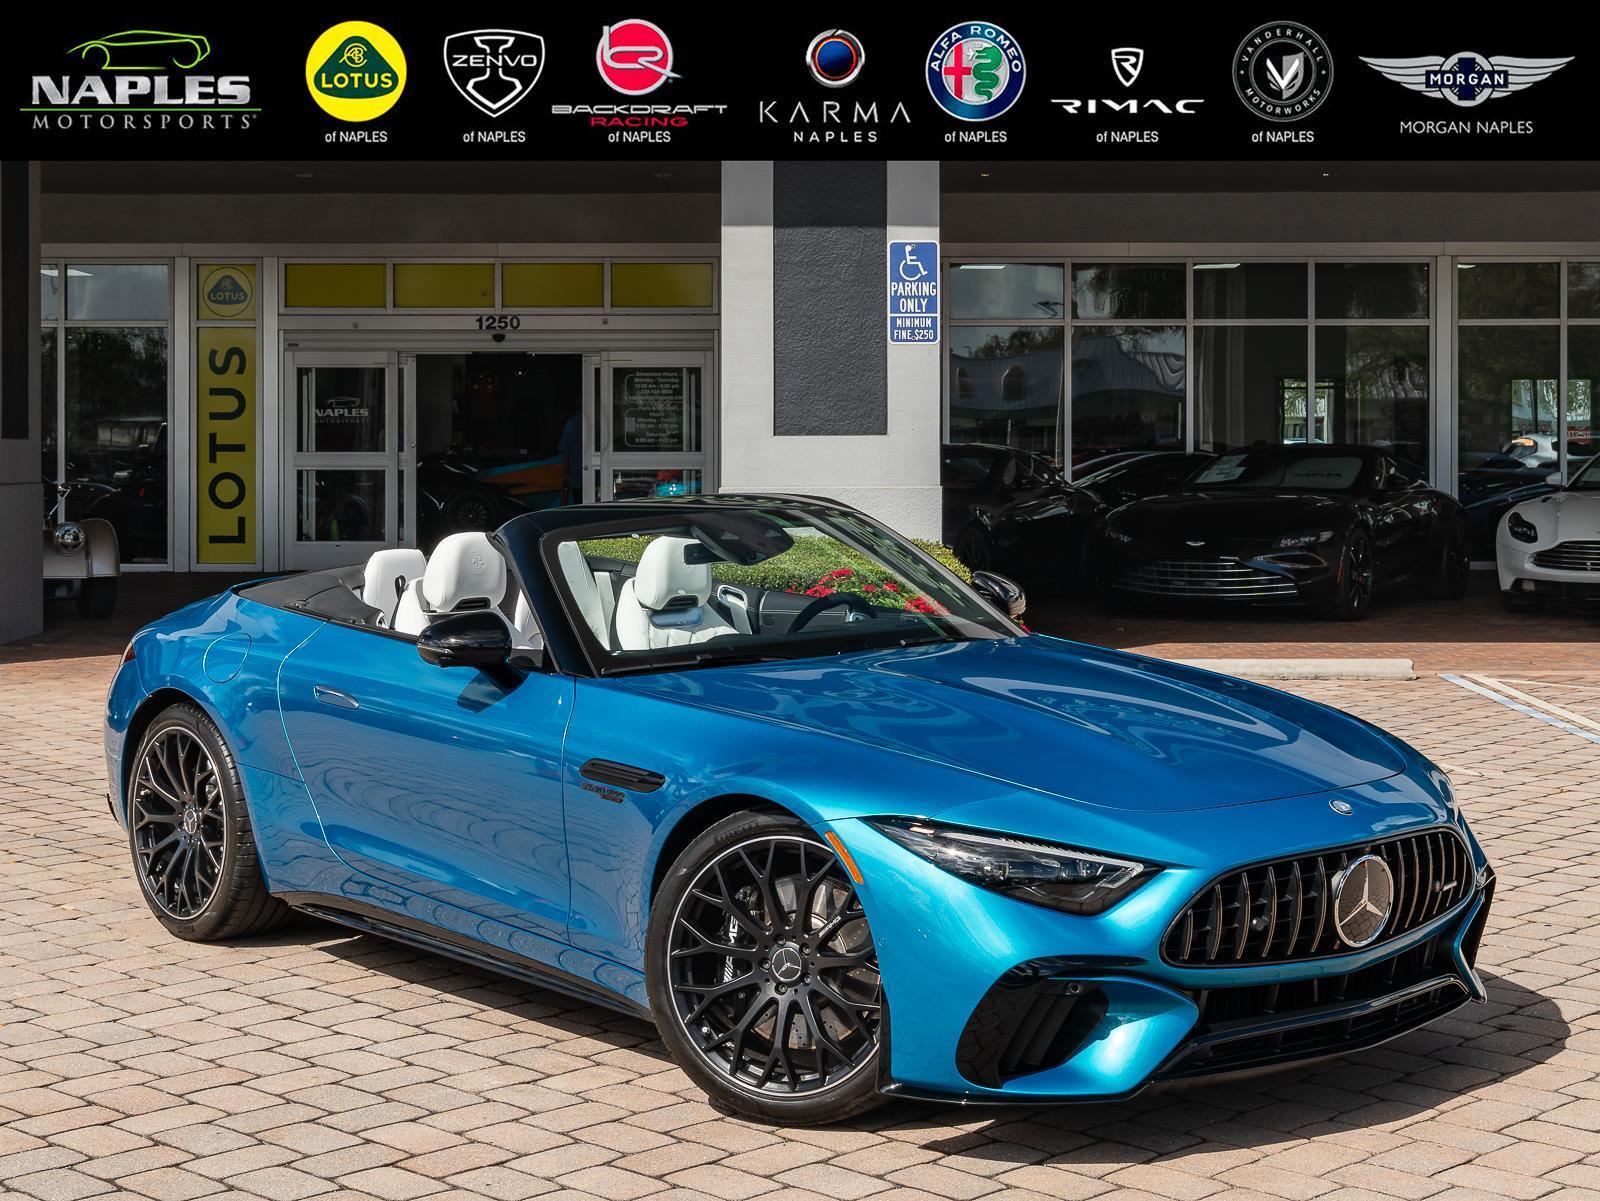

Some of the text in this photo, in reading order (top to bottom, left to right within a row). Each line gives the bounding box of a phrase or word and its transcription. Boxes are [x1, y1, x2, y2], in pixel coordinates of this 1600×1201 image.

[891, 281, 937, 296] PARKING
[210, 292, 245, 300] LOTUS
[900, 298, 928, 312] ONLY
[476, 316, 520, 330] 1250
[896, 317, 932, 327] MINIMUM
[894, 329, 934, 340] FINE $250
[208, 346, 247, 544] LOTUS
